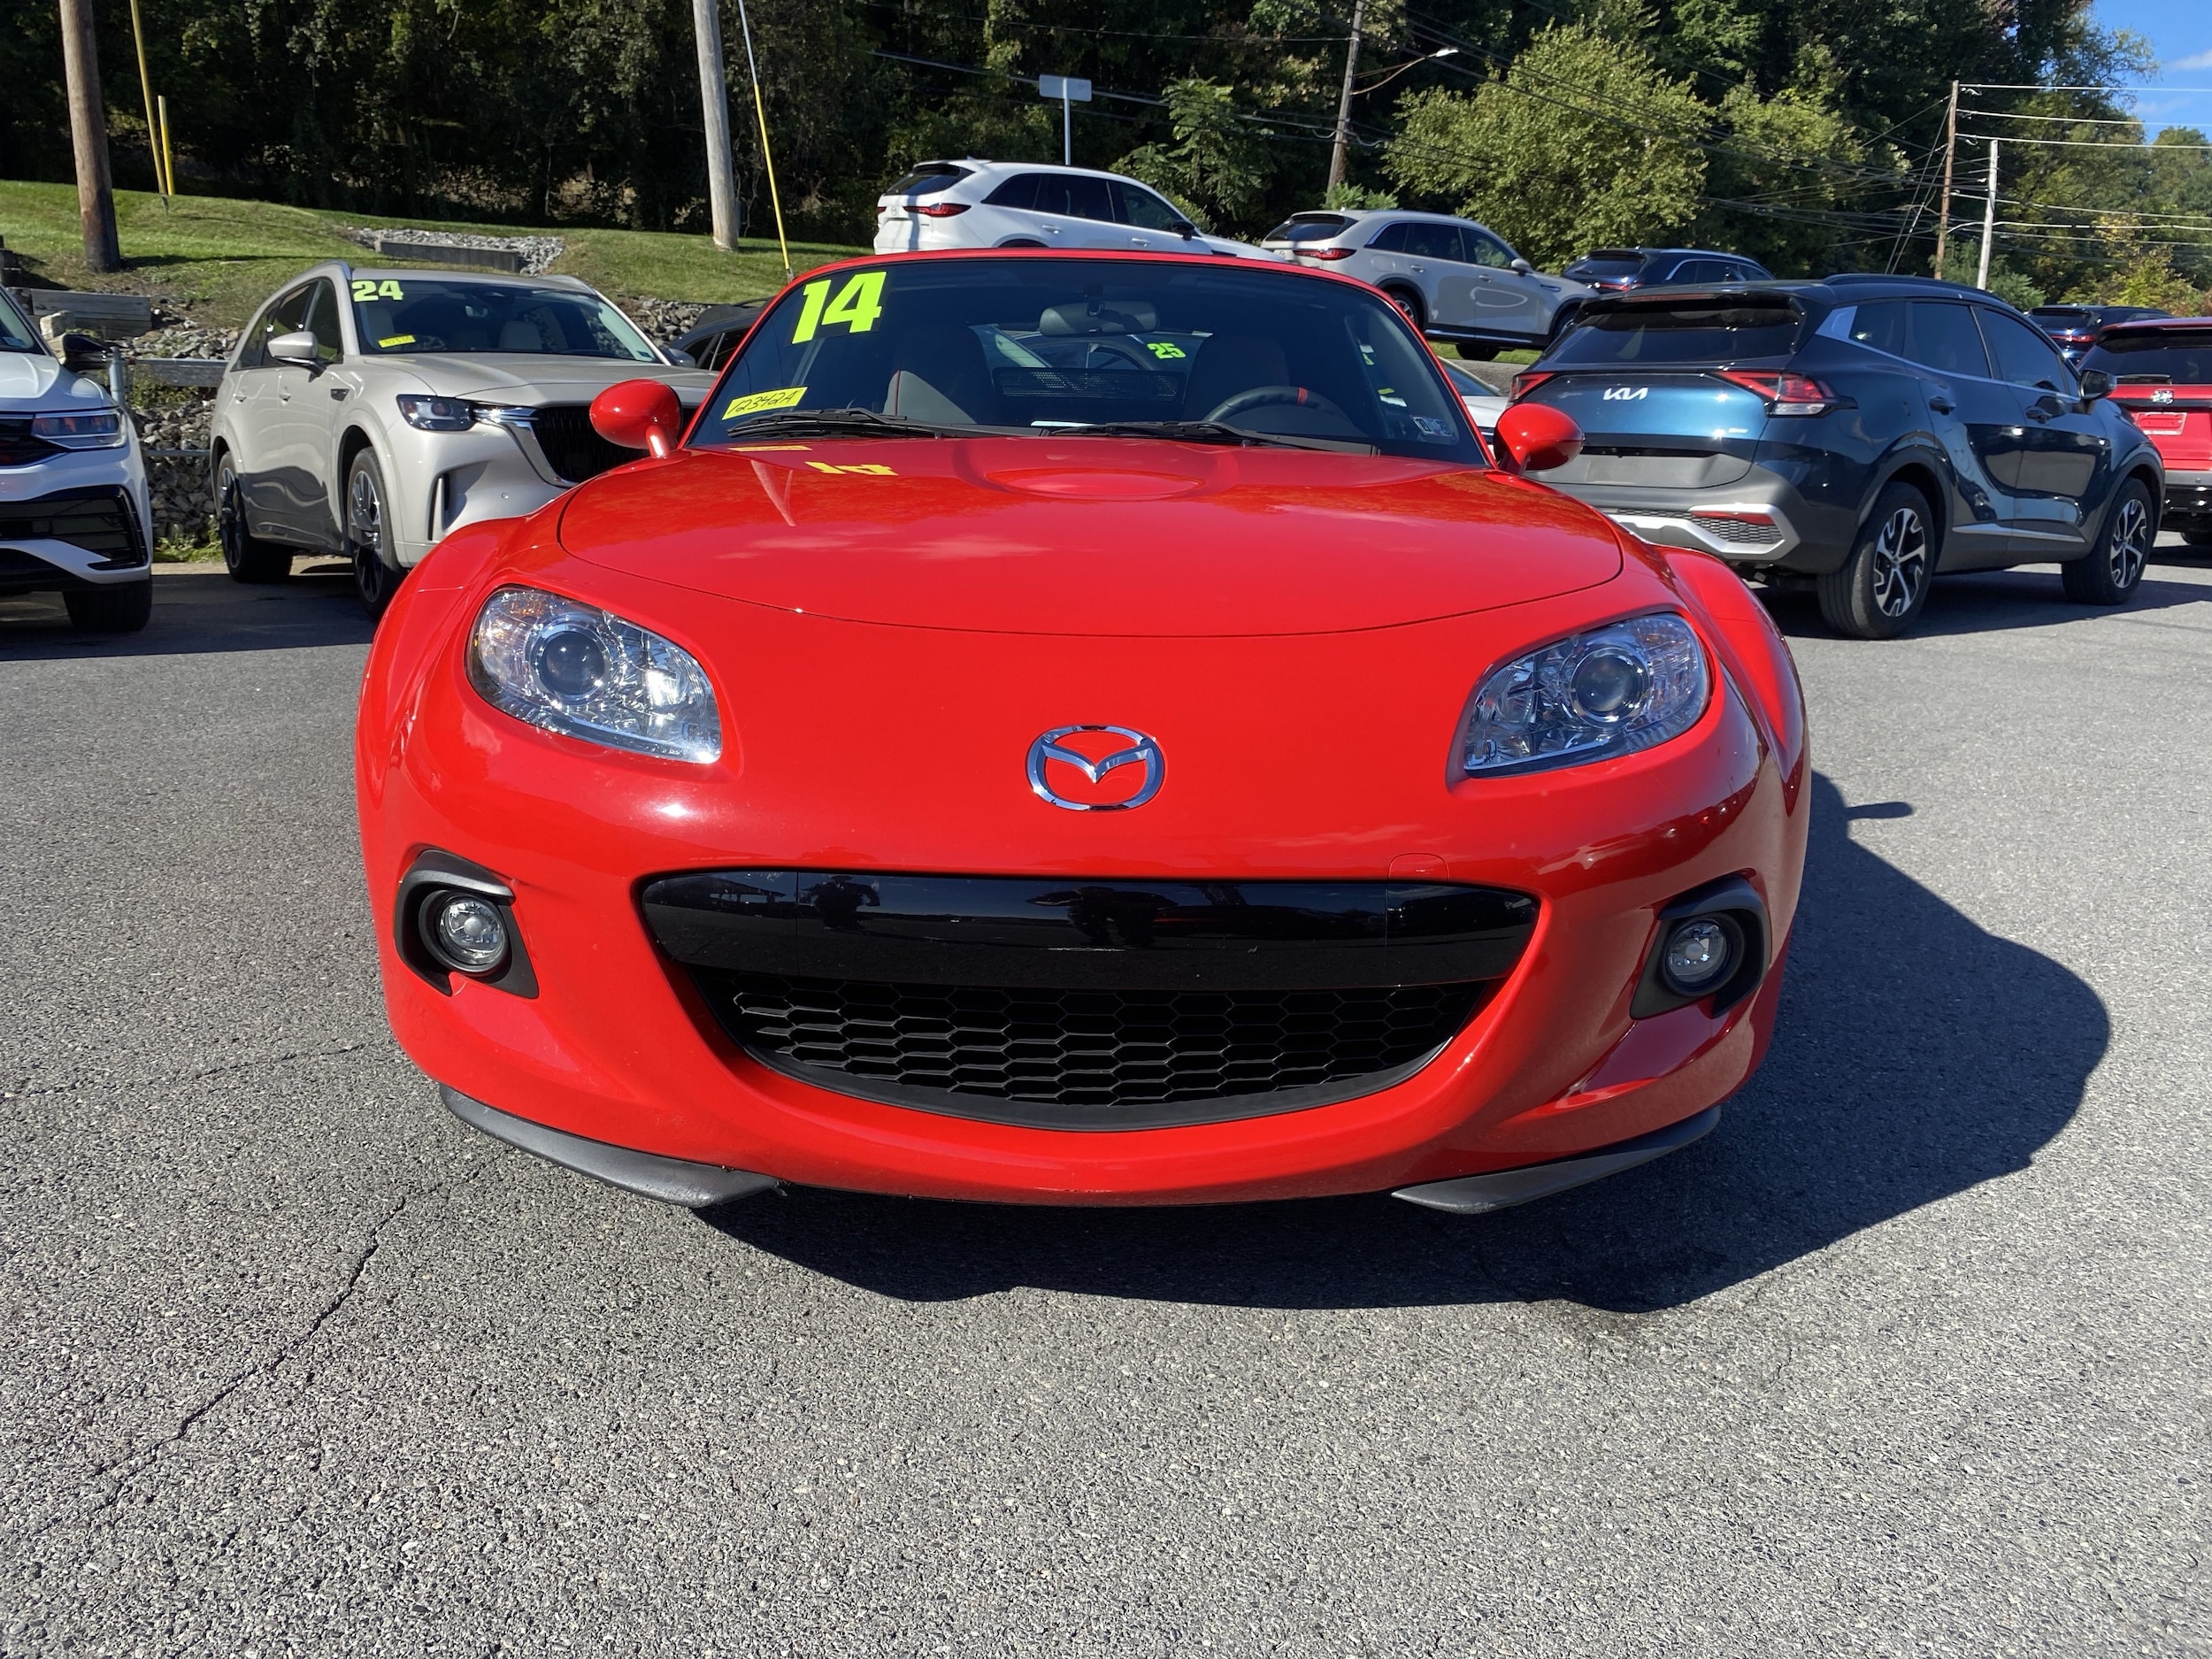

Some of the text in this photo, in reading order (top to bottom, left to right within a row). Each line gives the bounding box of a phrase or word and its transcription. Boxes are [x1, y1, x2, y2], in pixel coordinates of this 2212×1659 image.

[351, 280, 404, 302] 24
[791, 271, 887, 344] 14
[1147, 342, 1187, 359] 25
[726, 390, 798, 415] 12342A
[1602, 387, 1648, 401] KIA
